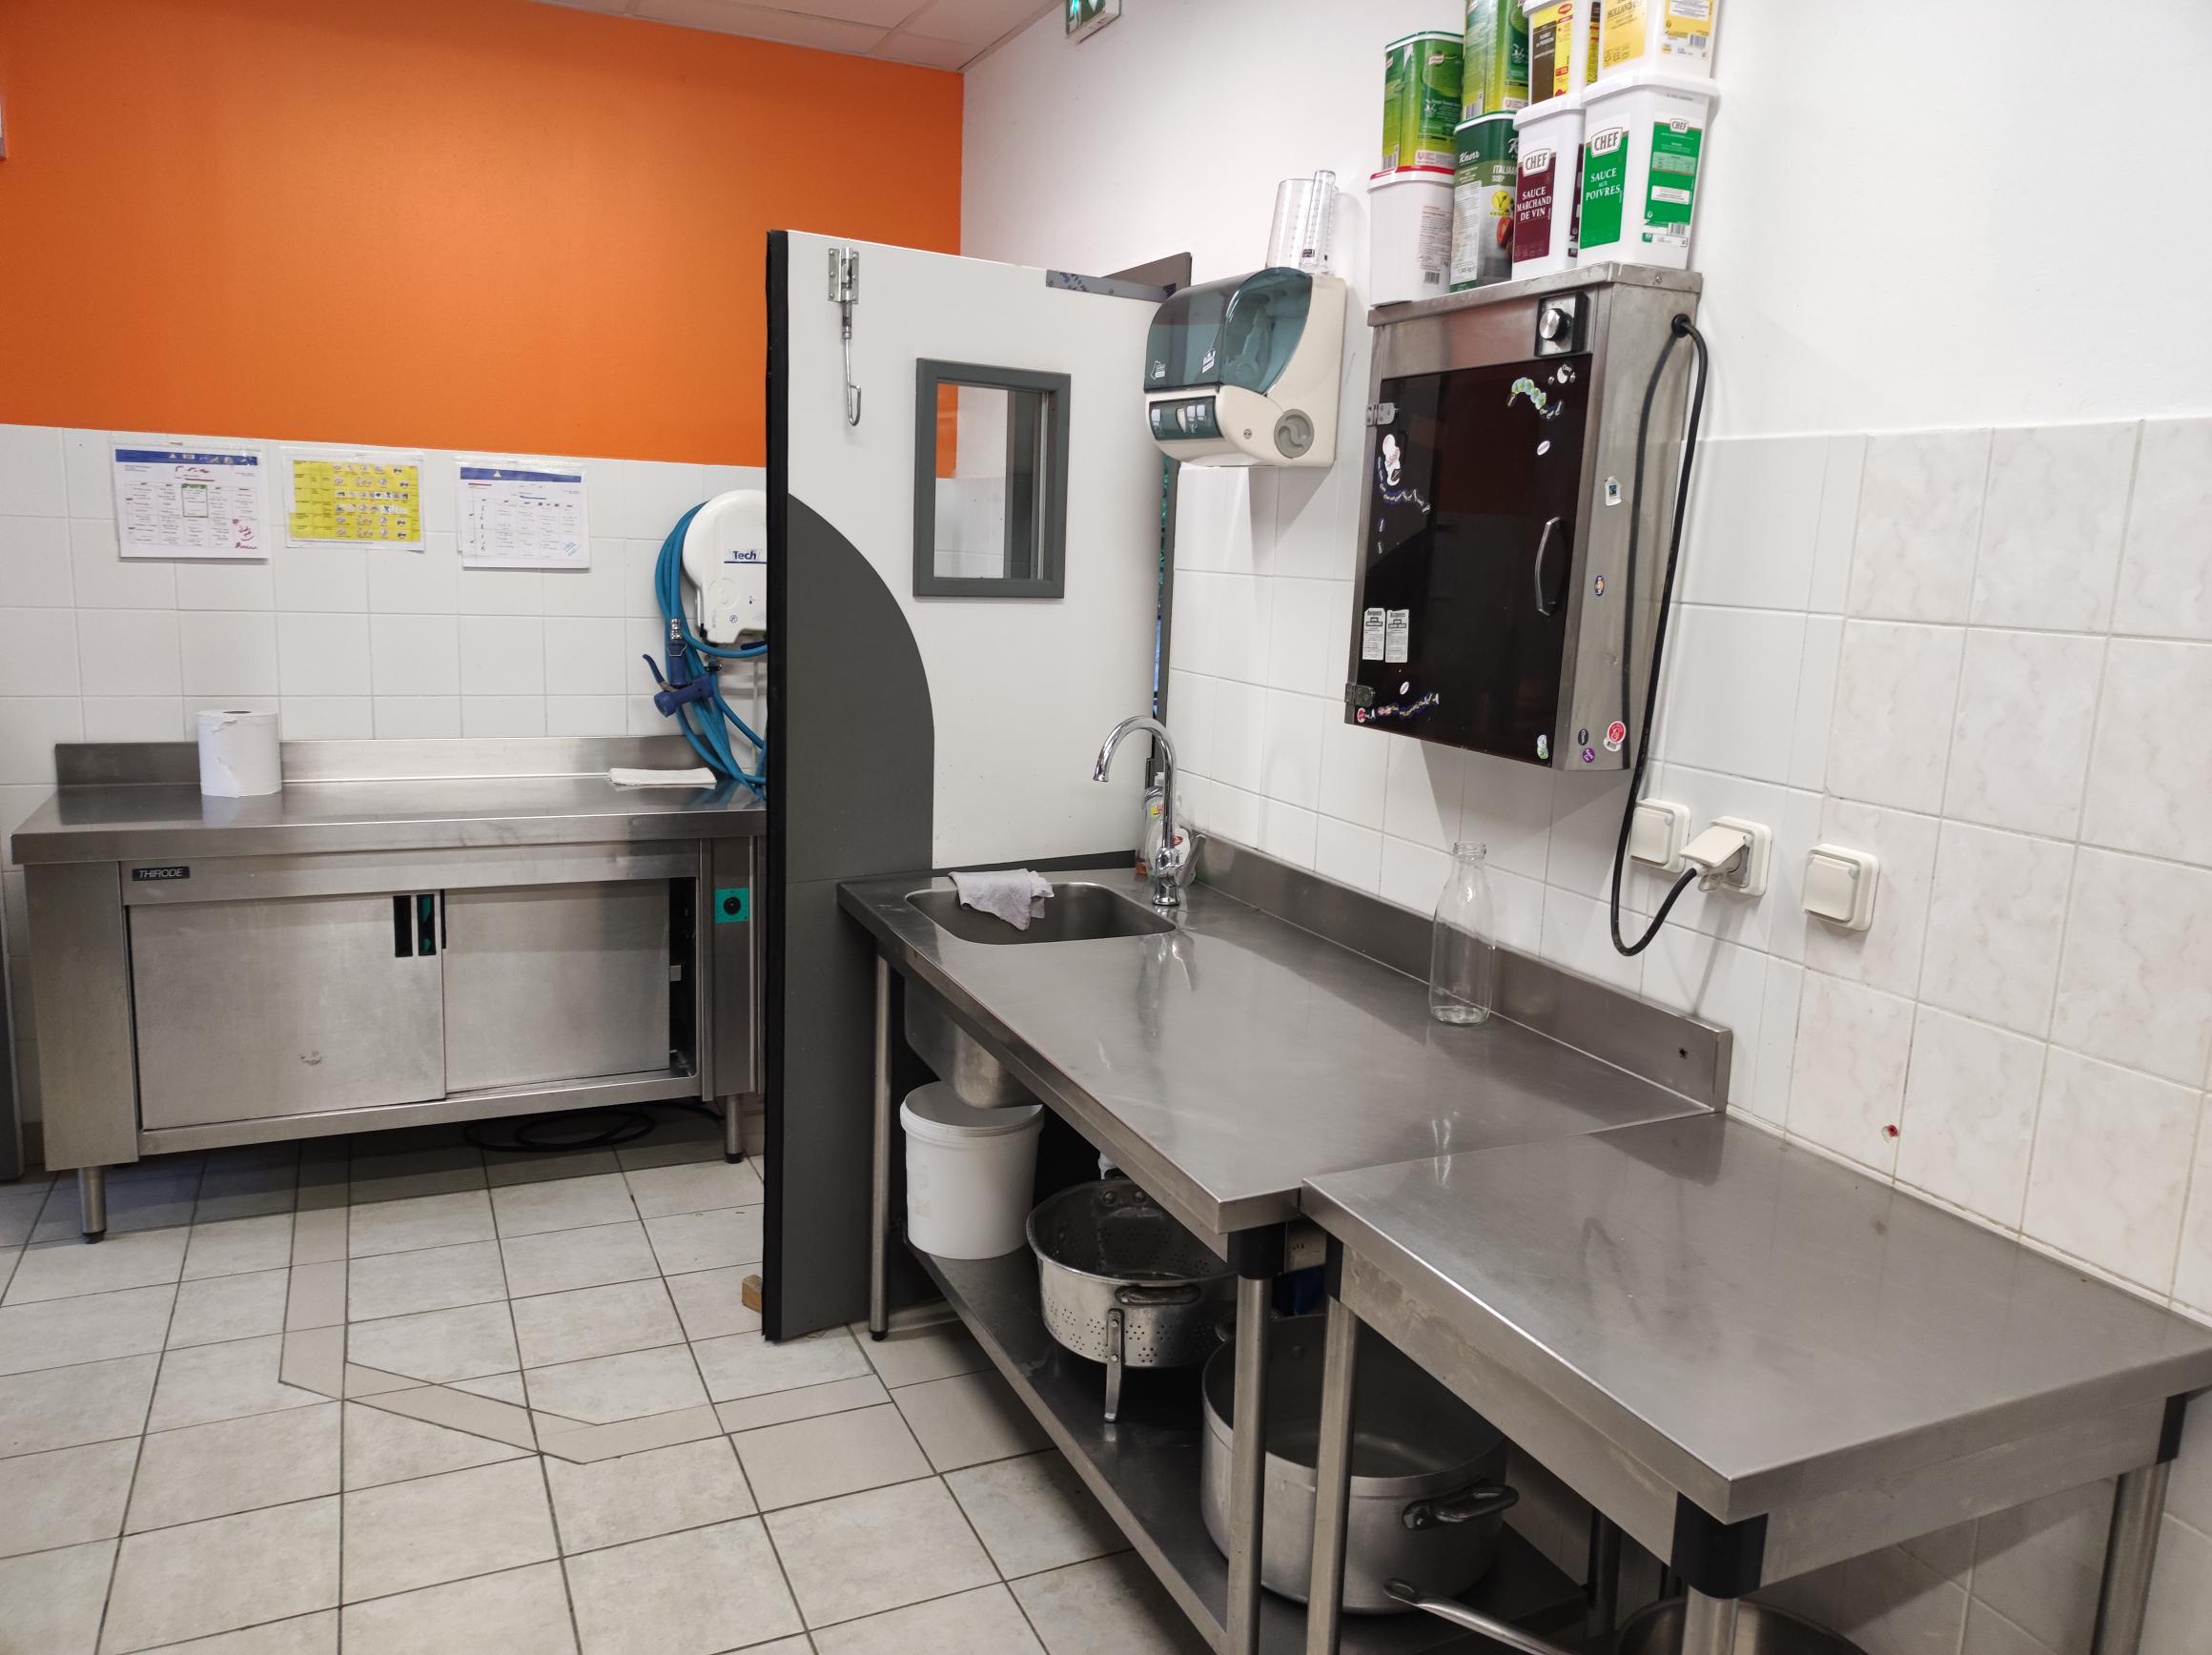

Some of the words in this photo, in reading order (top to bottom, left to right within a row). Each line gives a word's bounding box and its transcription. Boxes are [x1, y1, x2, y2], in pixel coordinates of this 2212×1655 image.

[1594, 132, 1619, 151] CHEF
[1459, 151, 1481, 164] Knorr
[1525, 153, 1547, 170] CHEF
[1590, 168, 1617, 182] SAUCE
[1522, 187, 1546, 199] SAUCE
[1586, 185, 1621, 201] POIVRES
[1517, 196, 1551, 212] MARCHAND
[1520, 211, 1530, 221] DE
[1532, 208, 1546, 217] VIN
[732, 550, 757, 561] Tech
[139, 868, 183, 878] THIRODE
